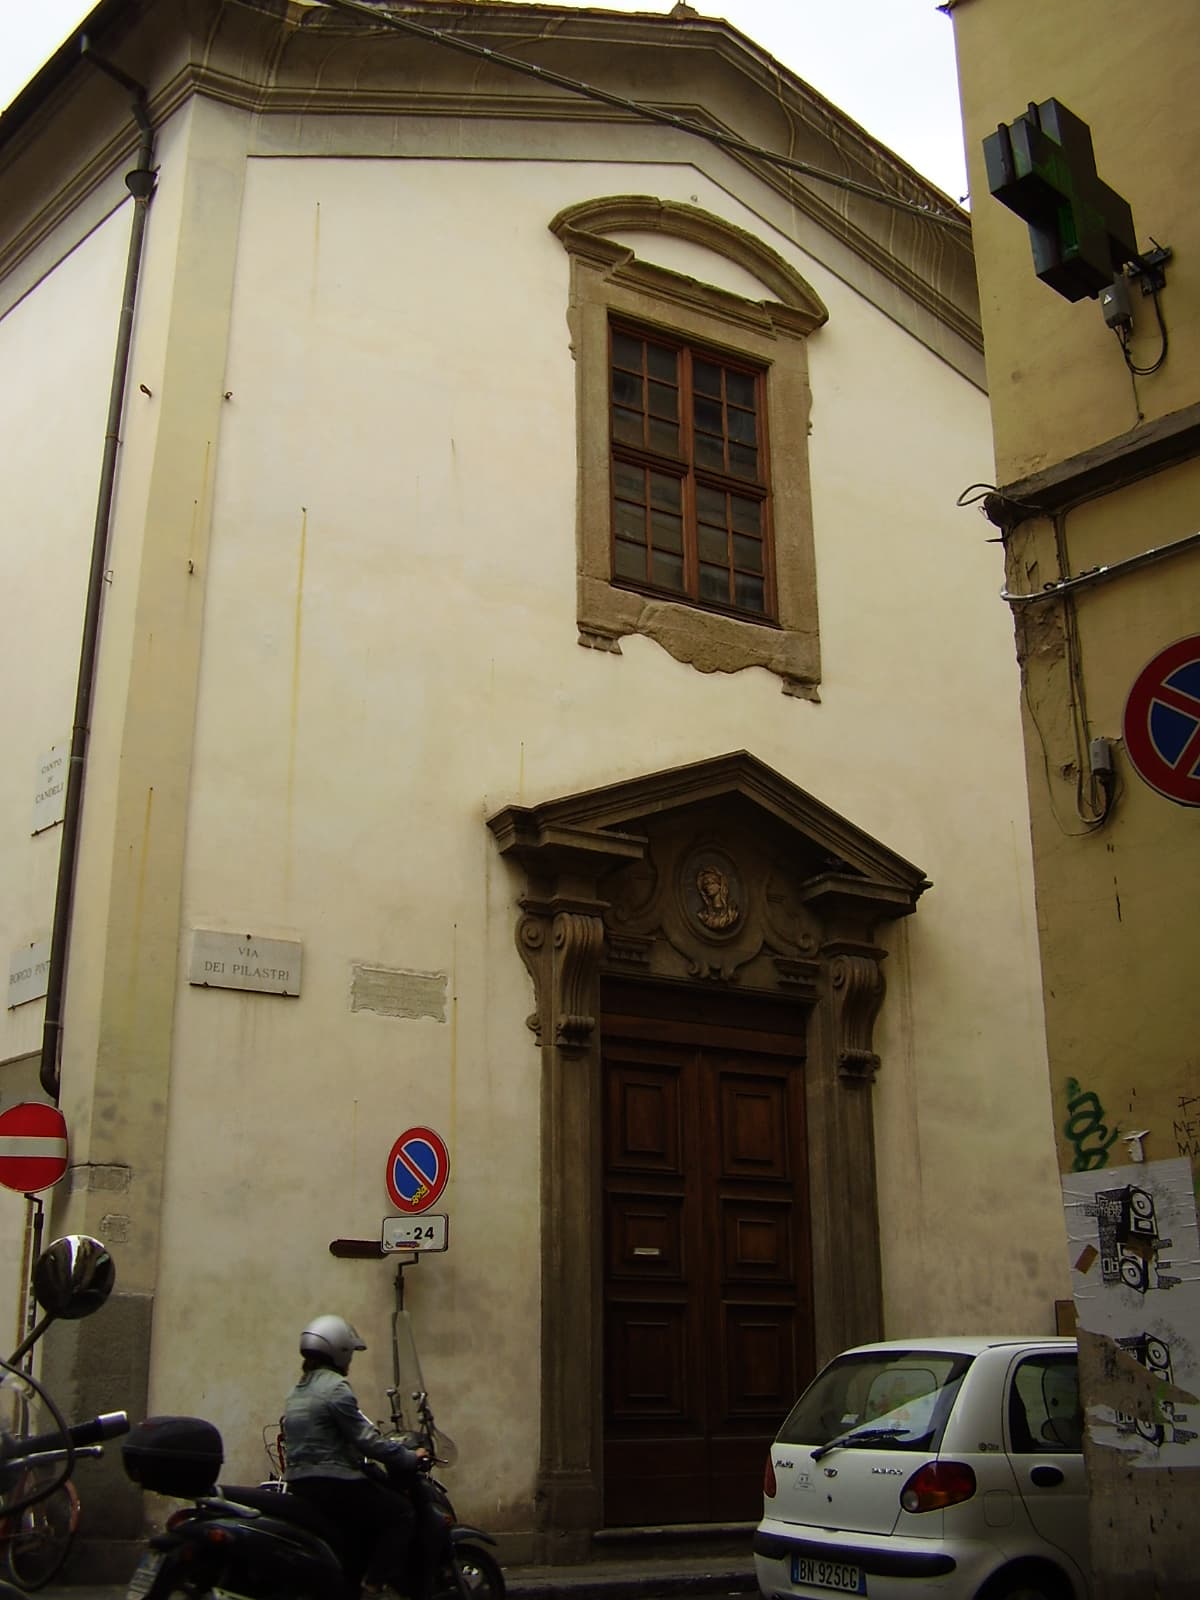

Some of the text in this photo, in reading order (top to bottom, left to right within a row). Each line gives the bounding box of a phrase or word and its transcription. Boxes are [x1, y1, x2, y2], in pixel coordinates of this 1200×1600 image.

[237, 946, 259, 958] VIA
[204, 960, 290, 981] DEI PILASTRI
[799, 1559, 815, 1582] BN
